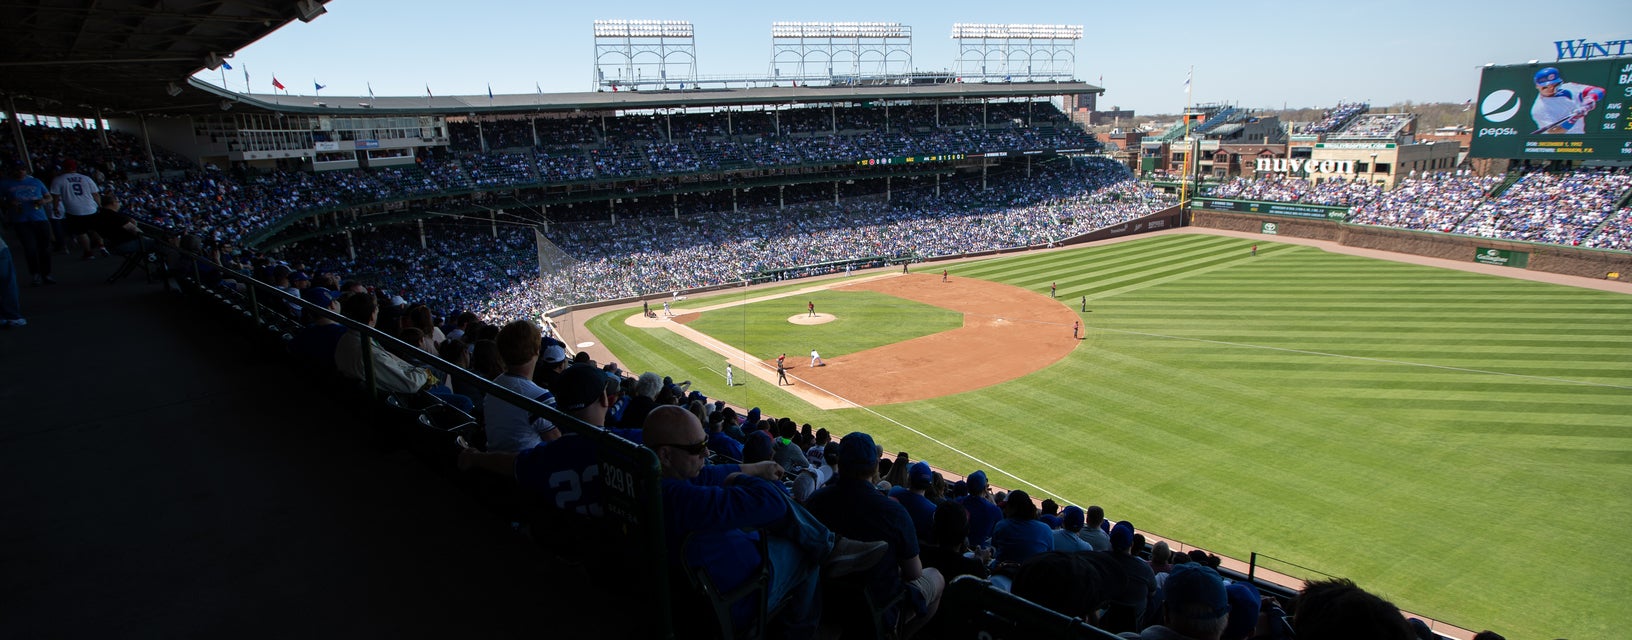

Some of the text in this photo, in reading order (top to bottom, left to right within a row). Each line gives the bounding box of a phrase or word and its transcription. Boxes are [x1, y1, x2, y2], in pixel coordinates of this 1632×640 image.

[1479, 127, 1516, 138] pepsi
[1256, 158, 1354, 174] nuveen
[72, 184, 83, 195] 9
[603, 462, 635, 498] 329 R
